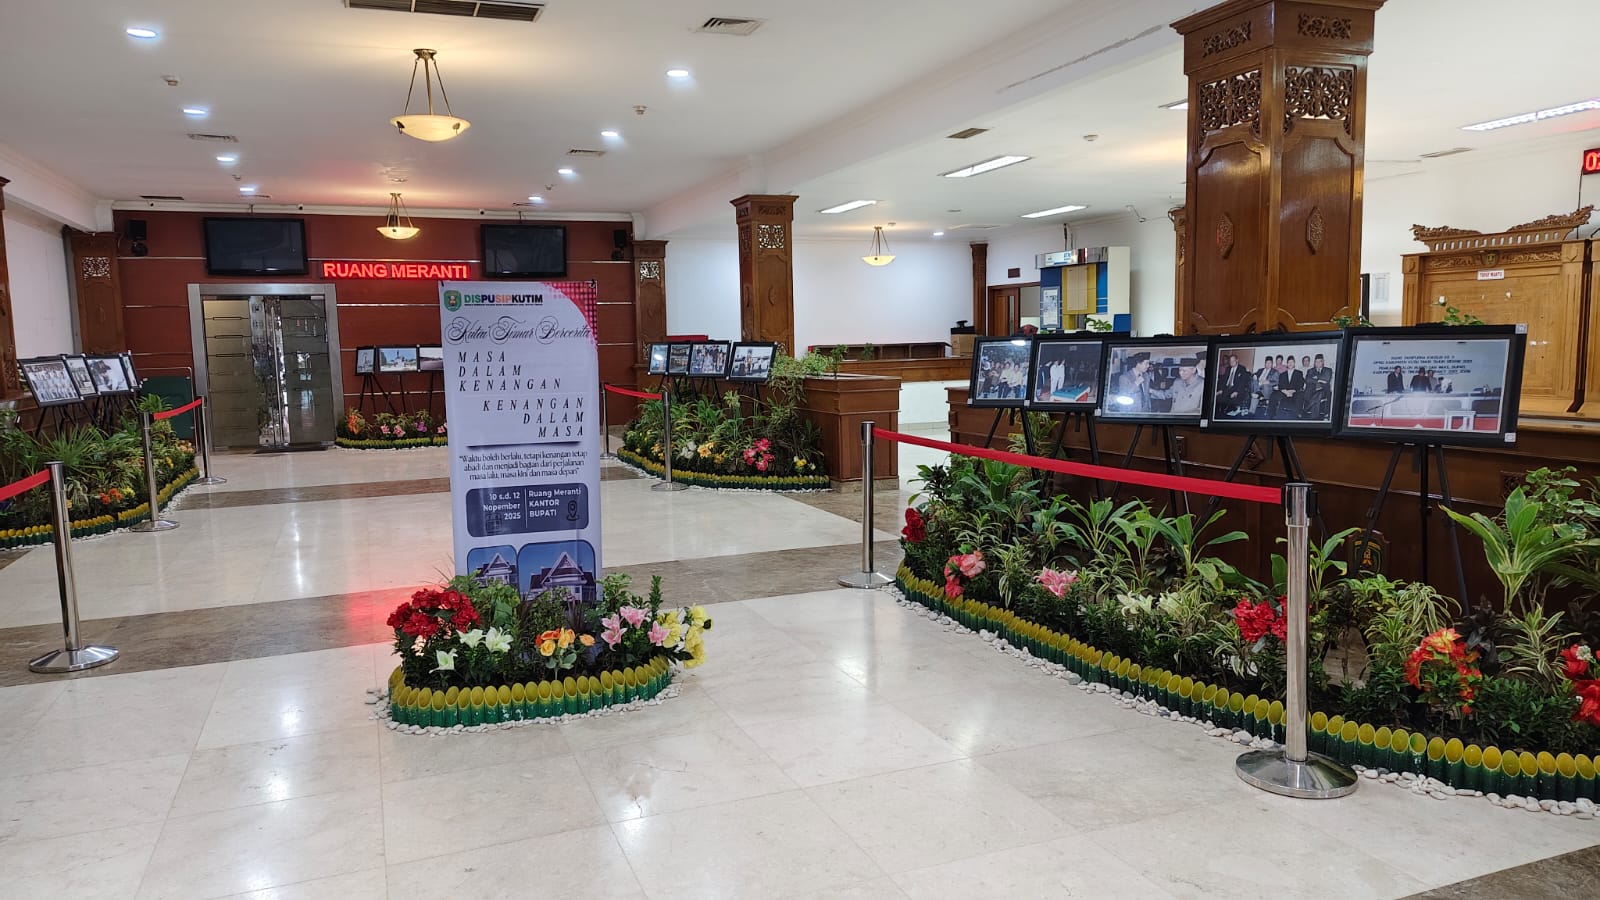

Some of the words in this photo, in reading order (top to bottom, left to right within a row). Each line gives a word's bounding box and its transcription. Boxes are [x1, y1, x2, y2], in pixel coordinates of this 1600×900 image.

[323, 262, 388, 278] RUANG
[391, 263, 468, 279] MERANTI
[463, 294, 544, 304] DISPUSIPKUTIM
[445, 316, 488, 345] Kutai
[488, 315, 534, 345] Timur
[535, 315, 592, 345] Bercerita
[458, 350, 506, 363] MASA
[458, 365, 521, 378] DALAM
[459, 378, 561, 392] KENANGAN
[483, 397, 584, 412] KENANGAN
[523, 411, 584, 425] DALAM
[538, 425, 584, 438] MASA
[481, 462, 494, 471] dan
[500, 471, 517, 479] masa
[529, 468, 541, 477] dan
[541, 469, 558, 477] masa
[498, 492, 511, 500] s.d.
[528, 490, 552, 498] Ruang
[553, 488, 582, 497] Meranti
[483, 502, 521, 513] Nopember
[529, 499, 560, 508] KANTOR
[503, 512, 521, 520] 2025
[529, 509, 557, 518] BUPATI
